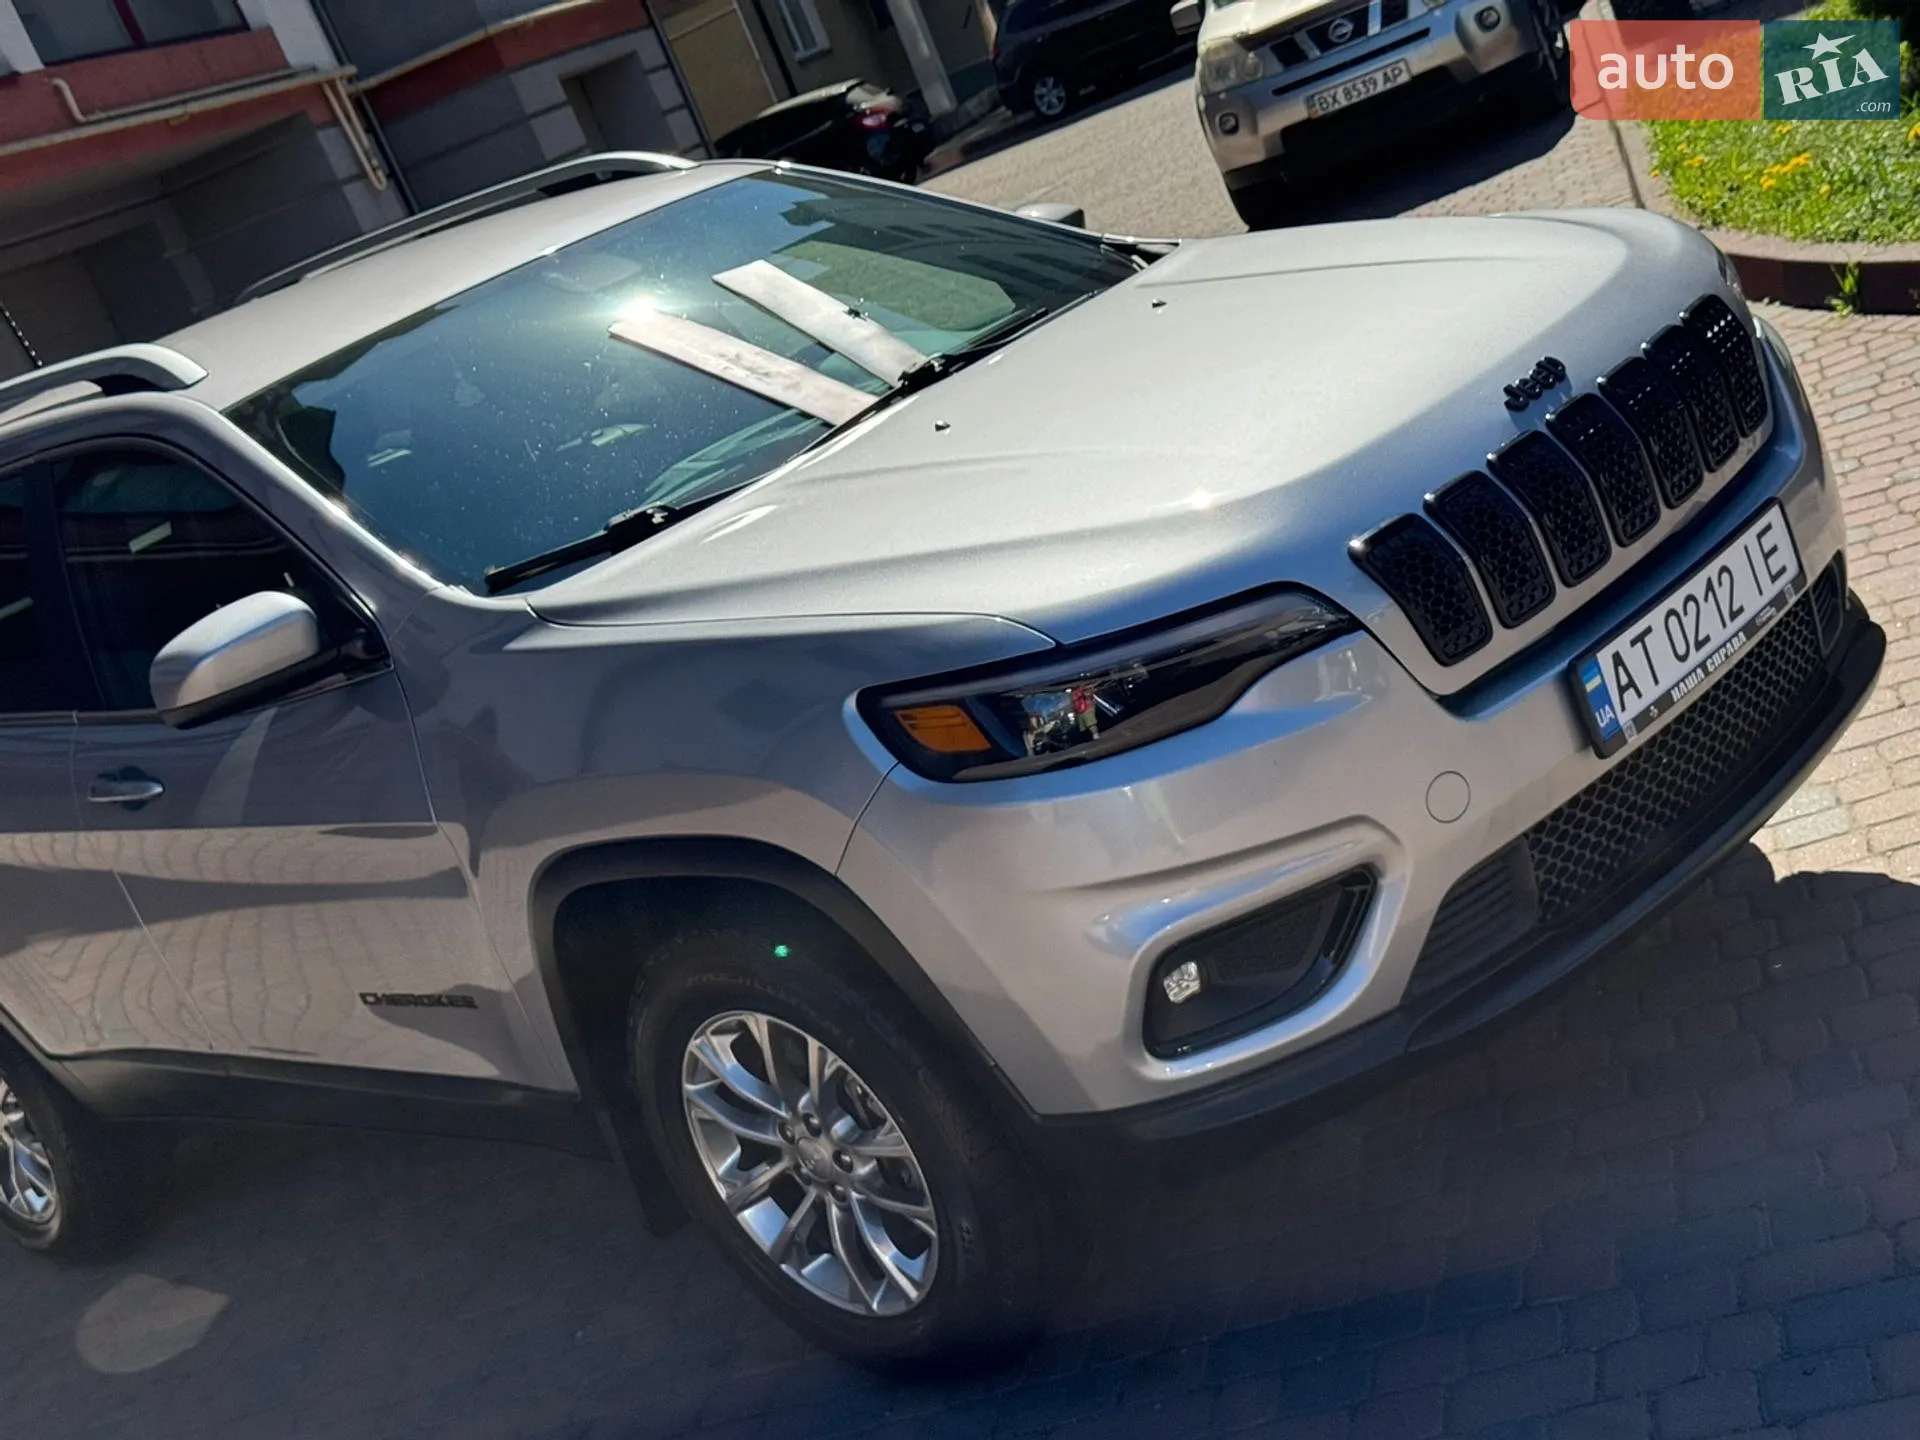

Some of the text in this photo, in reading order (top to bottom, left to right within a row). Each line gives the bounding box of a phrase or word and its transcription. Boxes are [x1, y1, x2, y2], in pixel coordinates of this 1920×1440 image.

[1503, 356, 1566, 412] Jeep
[1611, 522, 1788, 713] AT 0212 IE
[1670, 667, 1706, 702] НАША
[1595, 704, 1615, 728] UA
[359, 992, 478, 1009] CHEROKEE
